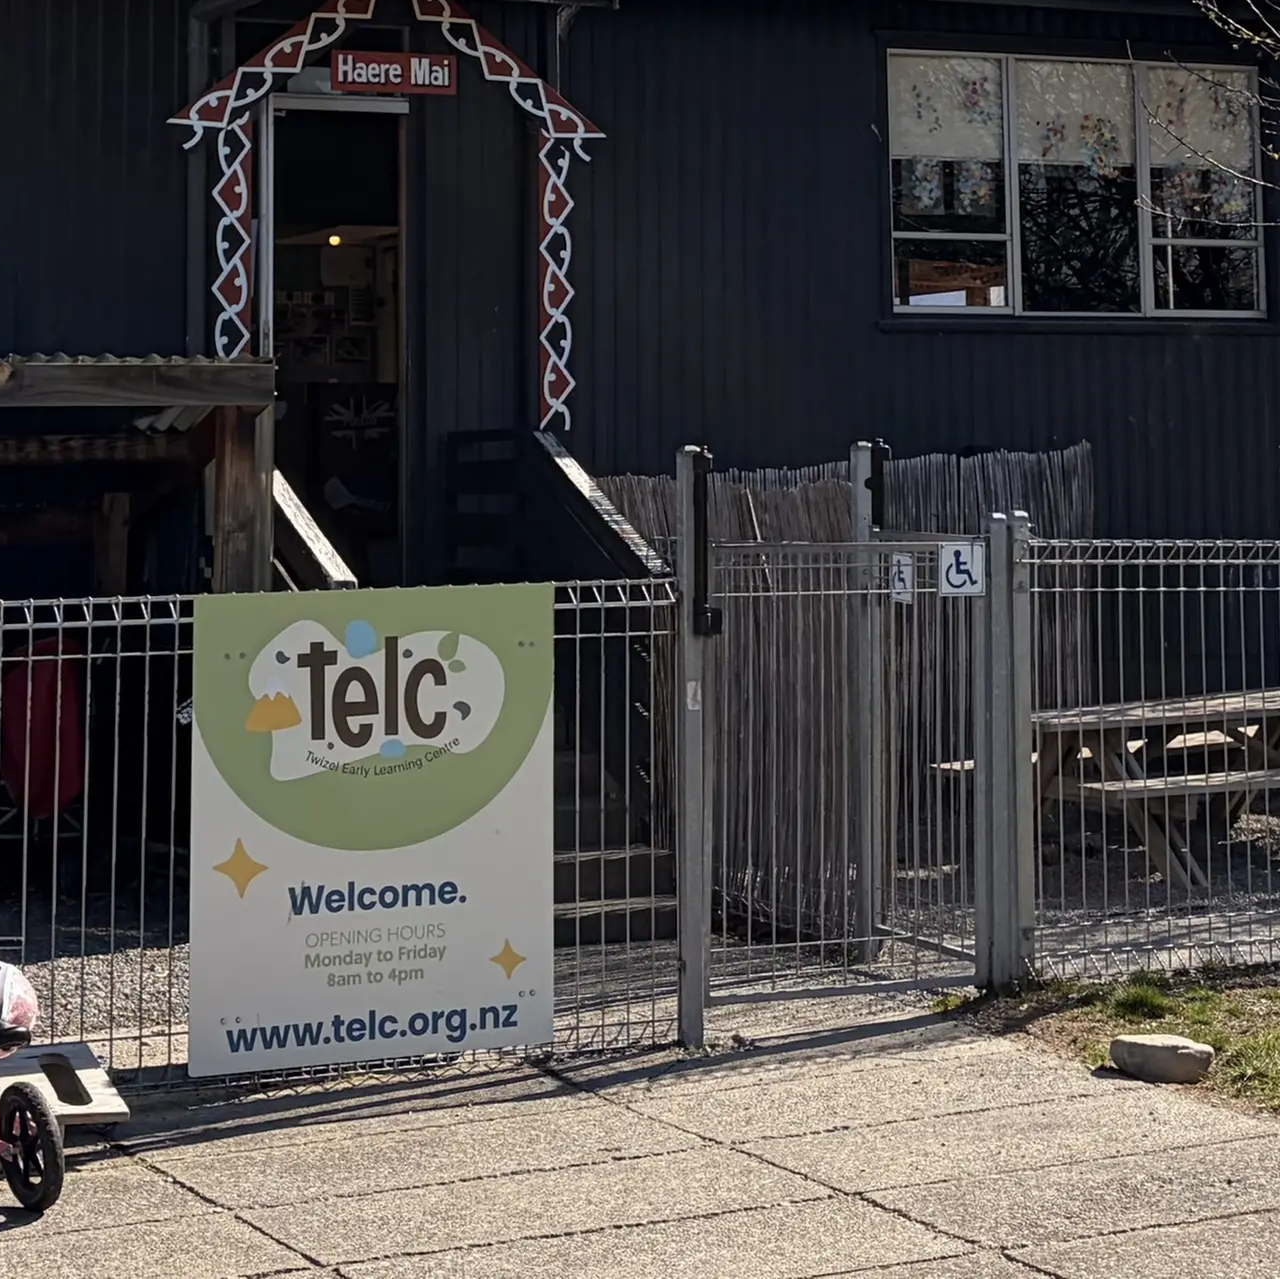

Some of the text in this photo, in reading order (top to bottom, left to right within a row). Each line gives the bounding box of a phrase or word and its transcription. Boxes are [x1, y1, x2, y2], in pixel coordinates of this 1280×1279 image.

[338, 54, 449, 86] Haere Mai
[297, 636, 447, 748] telc
[305, 737, 461, 778] Twizel Early Learning Centre
[288, 881, 467, 915] Welcome.
[305, 923, 446, 948] OPENING HOURS
[305, 944, 447, 969] Monday to Friday
[326, 967, 424, 987] 8am to 4pm
[226, 1004, 518, 1052] www.telc.org.nz
